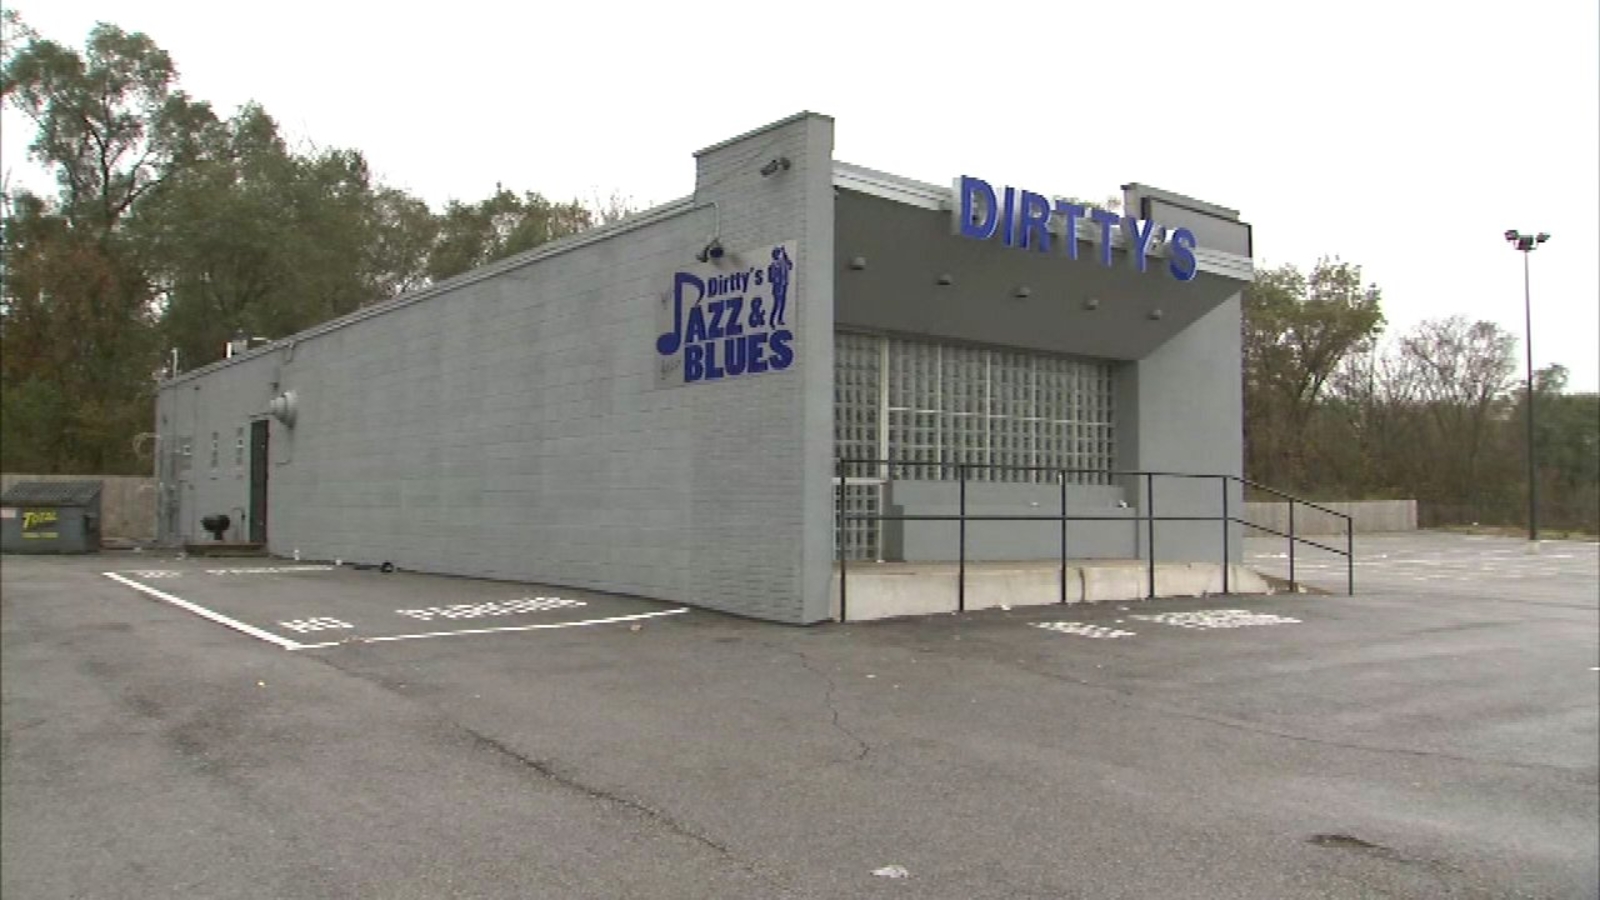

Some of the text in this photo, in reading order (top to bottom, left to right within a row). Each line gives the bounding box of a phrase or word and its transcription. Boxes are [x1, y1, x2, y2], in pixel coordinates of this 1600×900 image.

[957, 174, 1197, 281] DIRTTY'S
[707, 266, 763, 297] Dirtty's
[748, 297, 765, 328] &
[684, 329, 793, 382] BLUES
